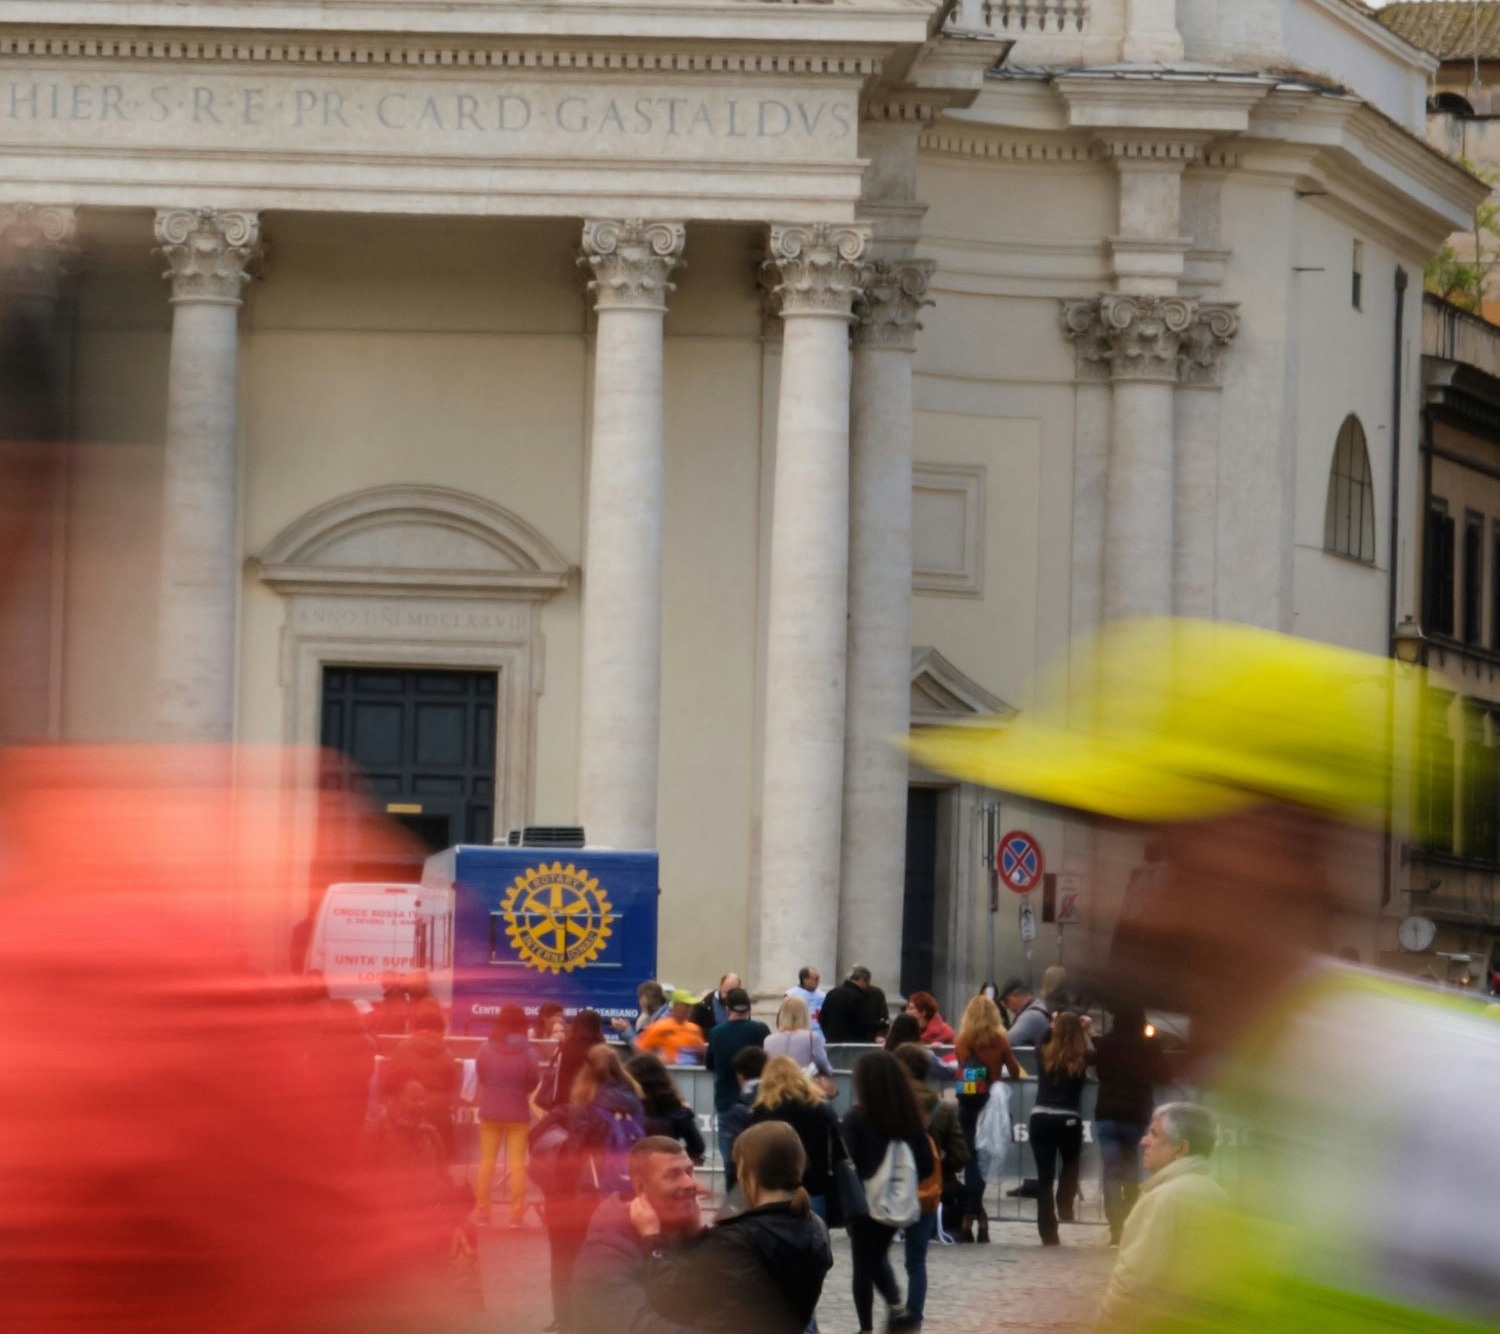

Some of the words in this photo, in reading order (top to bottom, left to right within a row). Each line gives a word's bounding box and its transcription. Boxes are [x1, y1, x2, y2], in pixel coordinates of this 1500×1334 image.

[8, 82, 130, 121] HIER
[192, 87, 221, 125] R
[243, 88, 266, 126] E
[293, 89, 349, 128] PR
[376, 92, 533, 133] CARD
[556, 97, 852, 139] GASTALDVS
